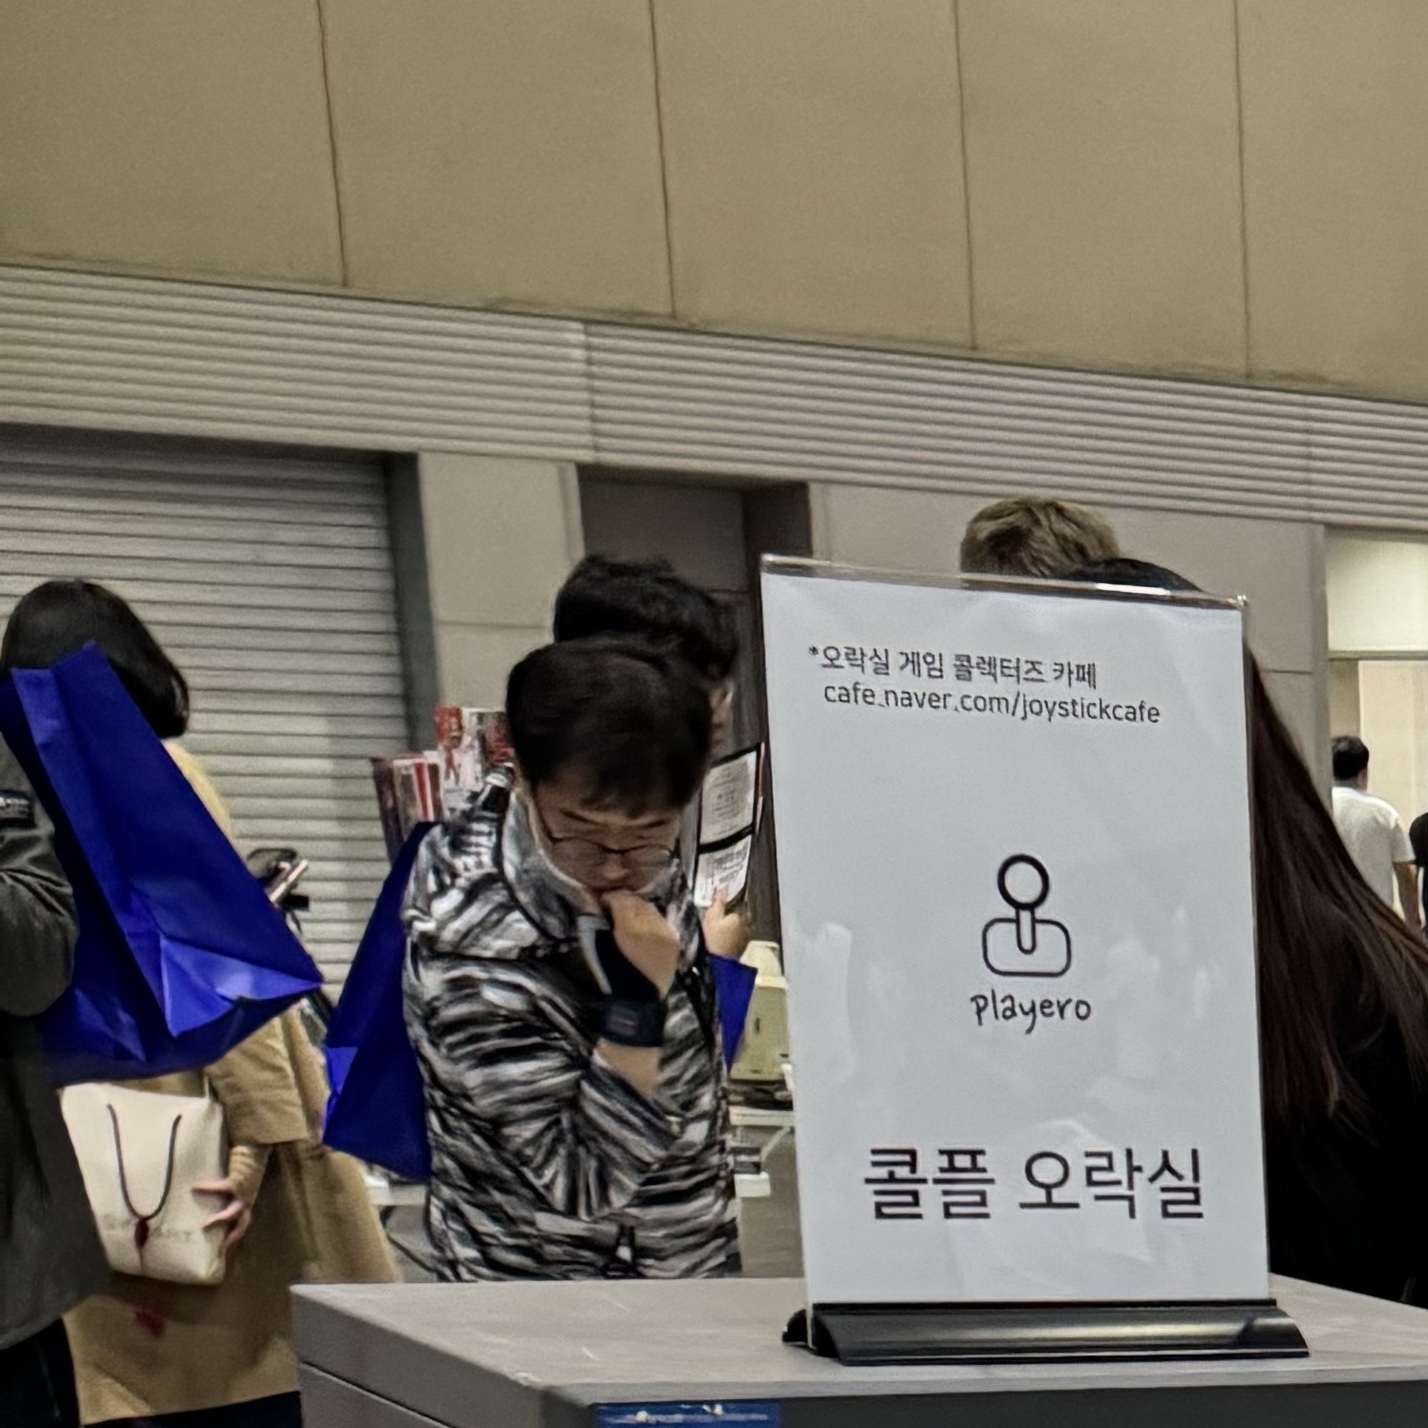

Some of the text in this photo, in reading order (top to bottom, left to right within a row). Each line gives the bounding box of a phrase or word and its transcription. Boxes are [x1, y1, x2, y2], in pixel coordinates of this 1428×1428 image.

[897, 650, 946, 680] 게임
[953, 652, 1048, 686] 콜렉터즈
[1052, 658, 1098, 690] 카페
[823, 680, 1162, 725] cafe.naver.com/joystickcafe
[863, 1146, 1206, 1221] 콜플 오락실
